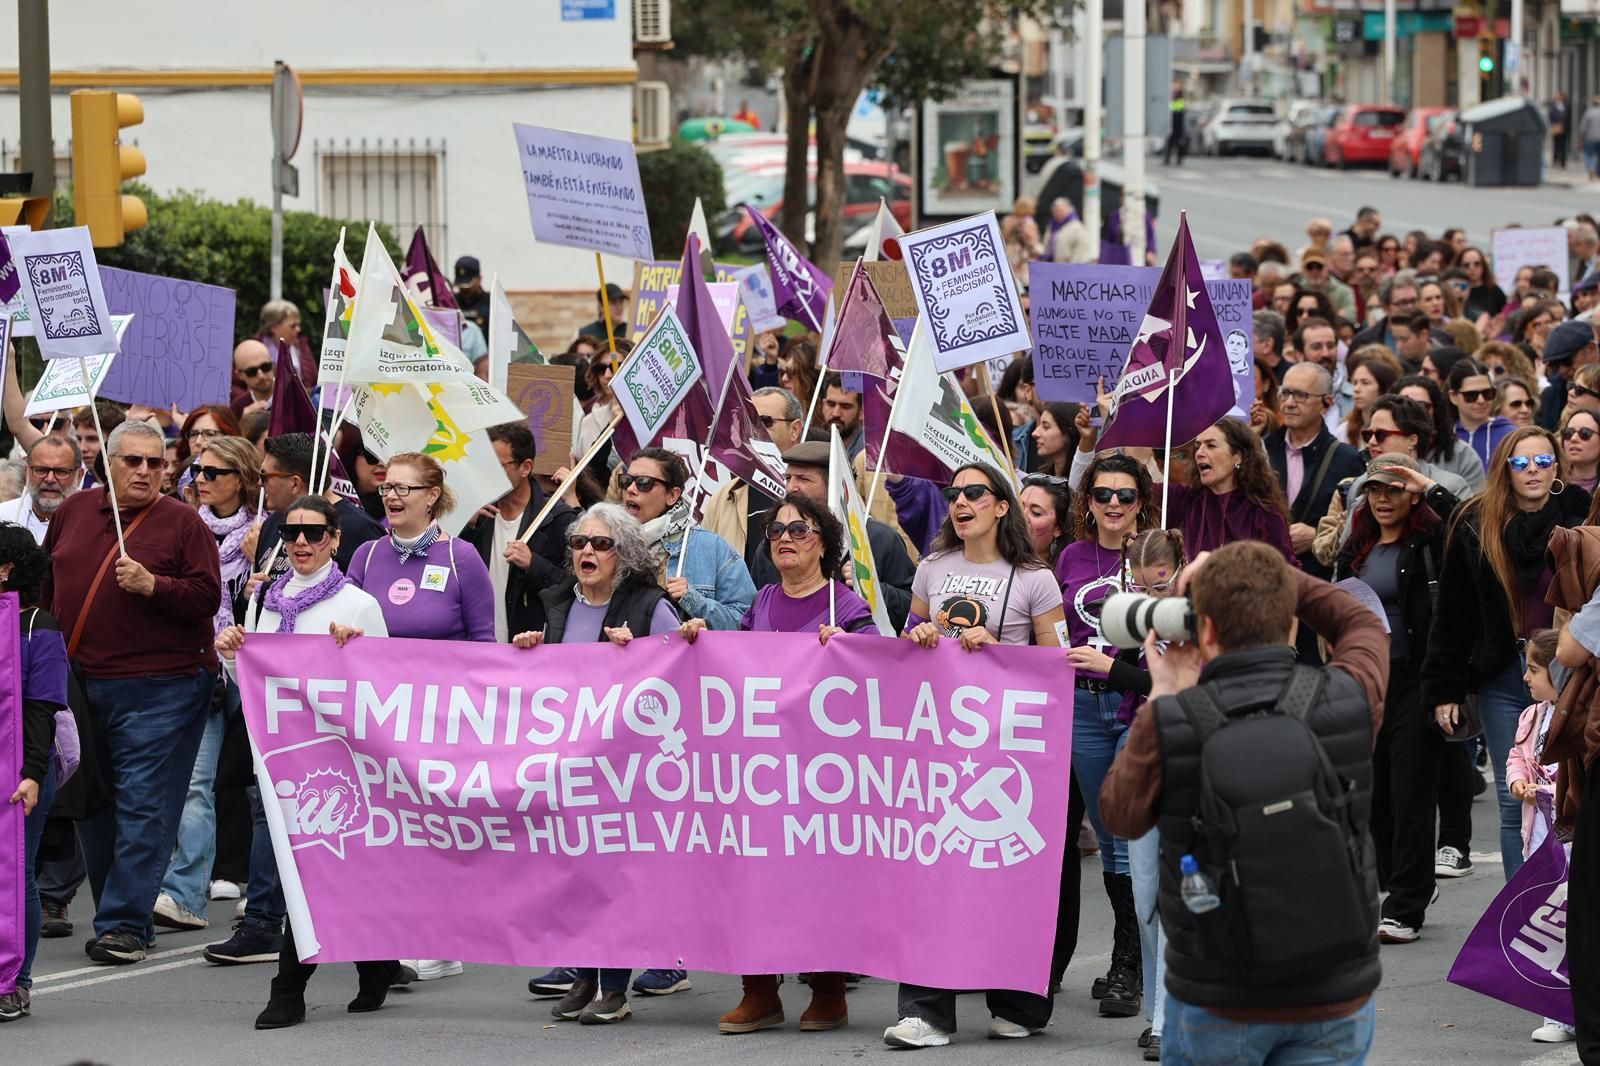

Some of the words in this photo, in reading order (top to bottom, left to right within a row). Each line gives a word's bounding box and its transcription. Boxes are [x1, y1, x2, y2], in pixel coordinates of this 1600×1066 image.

[526, 144, 537, 158] LA
[537, 146, 579, 163] MAESTRA
[39, 264, 68, 286] 8M
[930, 246, 972, 279] 8M
[941, 262, 997, 292] FEMINISMO
[942, 273, 995, 302] FASCISMO
[37, 283, 73, 297] Feminismo
[40, 294, 55, 305] para
[54, 286, 88, 303] cambiarlo
[72, 294, 90, 305] todo
[1206, 282, 1250, 301] UINAN
[1036, 307, 1088, 327] AUNQUE
[1094, 311, 1114, 325] NO
[1118, 310, 1137, 325] TE
[1037, 324, 1081, 343] FALTE
[1088, 325, 1132, 345] NADA
[658, 337, 684, 372] 8M
[1039, 344, 1098, 364] PORQUE
[1110, 347, 1123, 363] A
[377, 361, 453, 375] convocatoria
[645, 350, 677, 396] ANDALUZAS
[1042, 362, 1073, 382] LES
[924, 421, 971, 458] izquierda
[938, 571, 1008, 602] ¡BASTA!
[265, 675, 689, 759] FEMINISMO
[700, 675, 781, 744] DE
[809, 675, 1048, 754] CLASE
[353, 756, 500, 815] PARA
[513, 750, 957, 818] REVOLUCIONAR
[366, 805, 515, 859] DESDE
[524, 811, 712, 864] HUELVA
[719, 814, 768, 858] AL
[783, 812, 942, 867] MUNDO
[942, 828, 1031, 869] PCE
